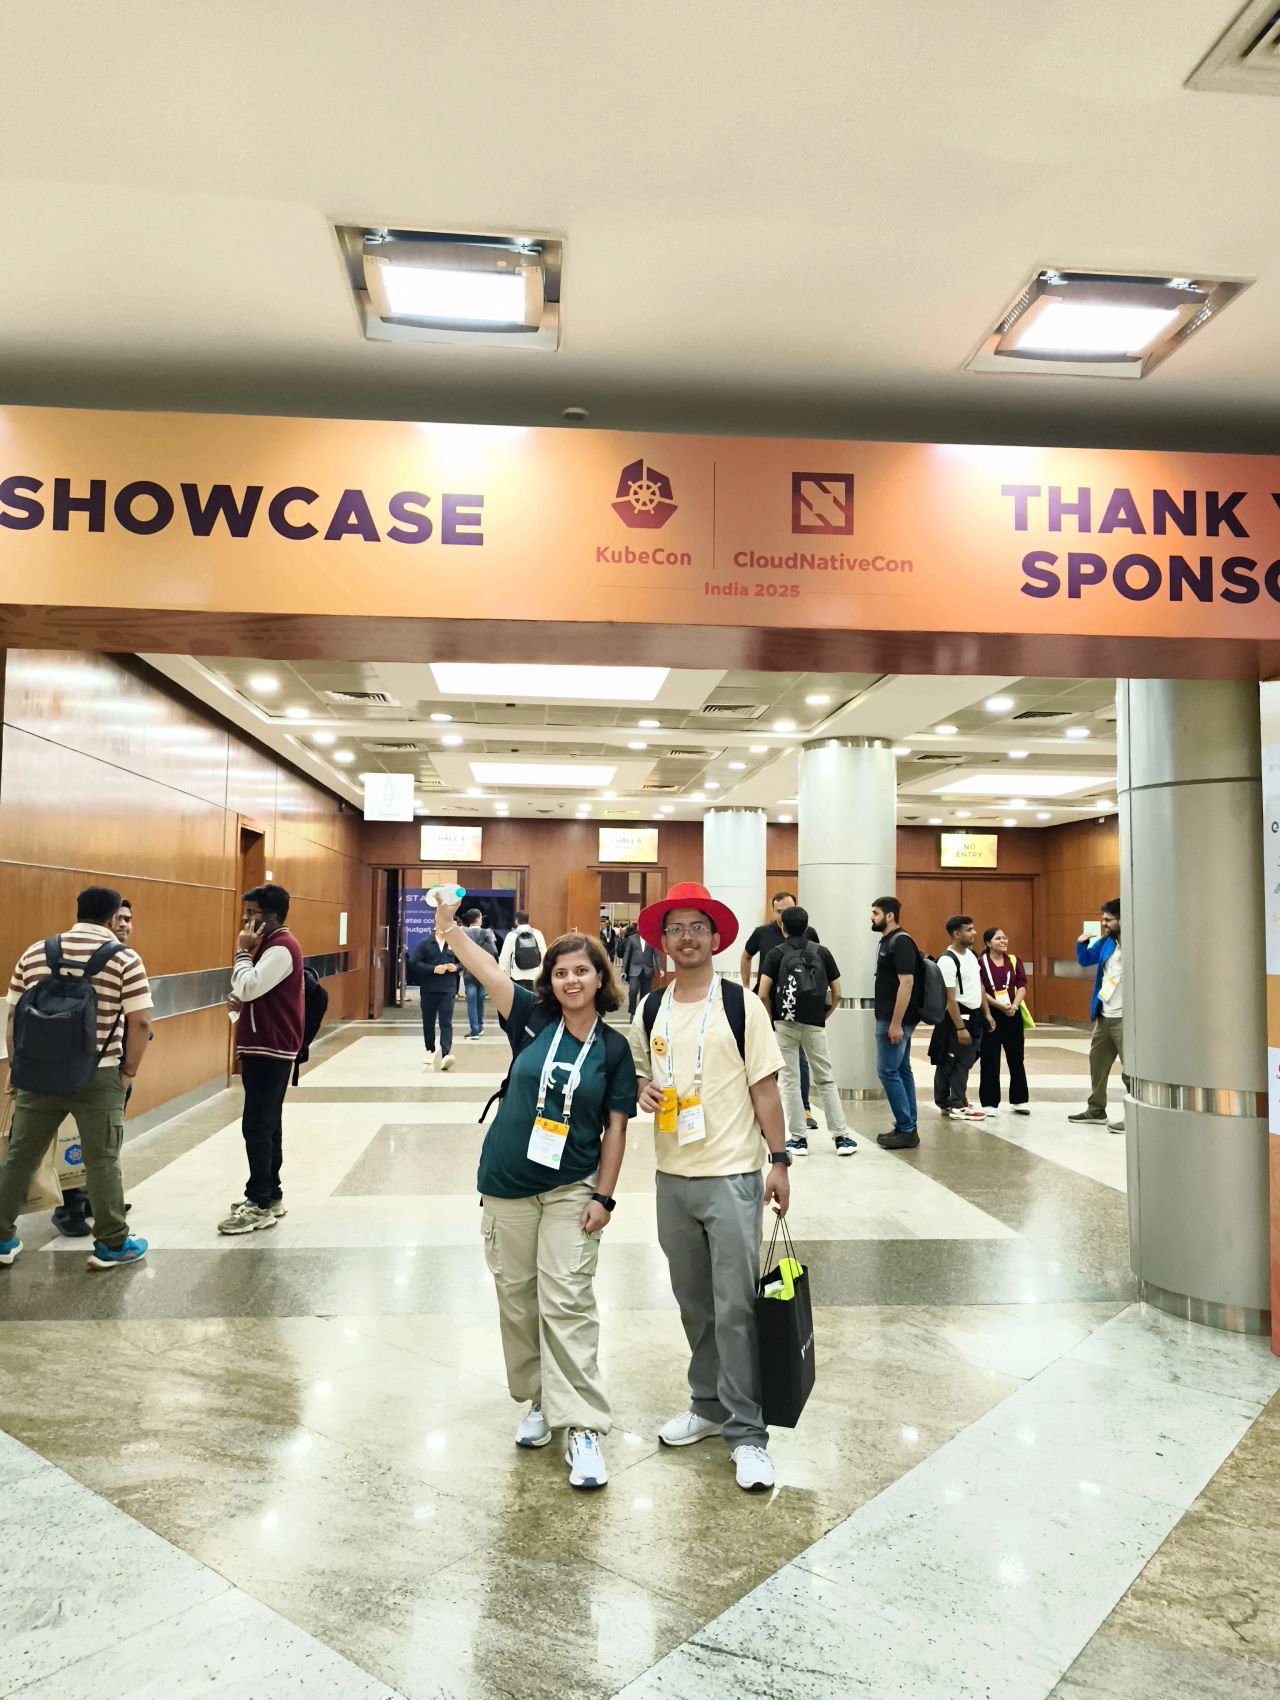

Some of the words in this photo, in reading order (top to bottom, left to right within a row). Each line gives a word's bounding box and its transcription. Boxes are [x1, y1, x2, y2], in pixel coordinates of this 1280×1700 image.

[0, 476, 484, 545] SHOWCASE
[1001, 484, 1248, 538] THANK
[596, 545, 692, 566] KubeCon
[733, 551, 914, 574] CloudNativeCon
[704, 581, 748, 598] India
[754, 583, 801, 598] 2025
